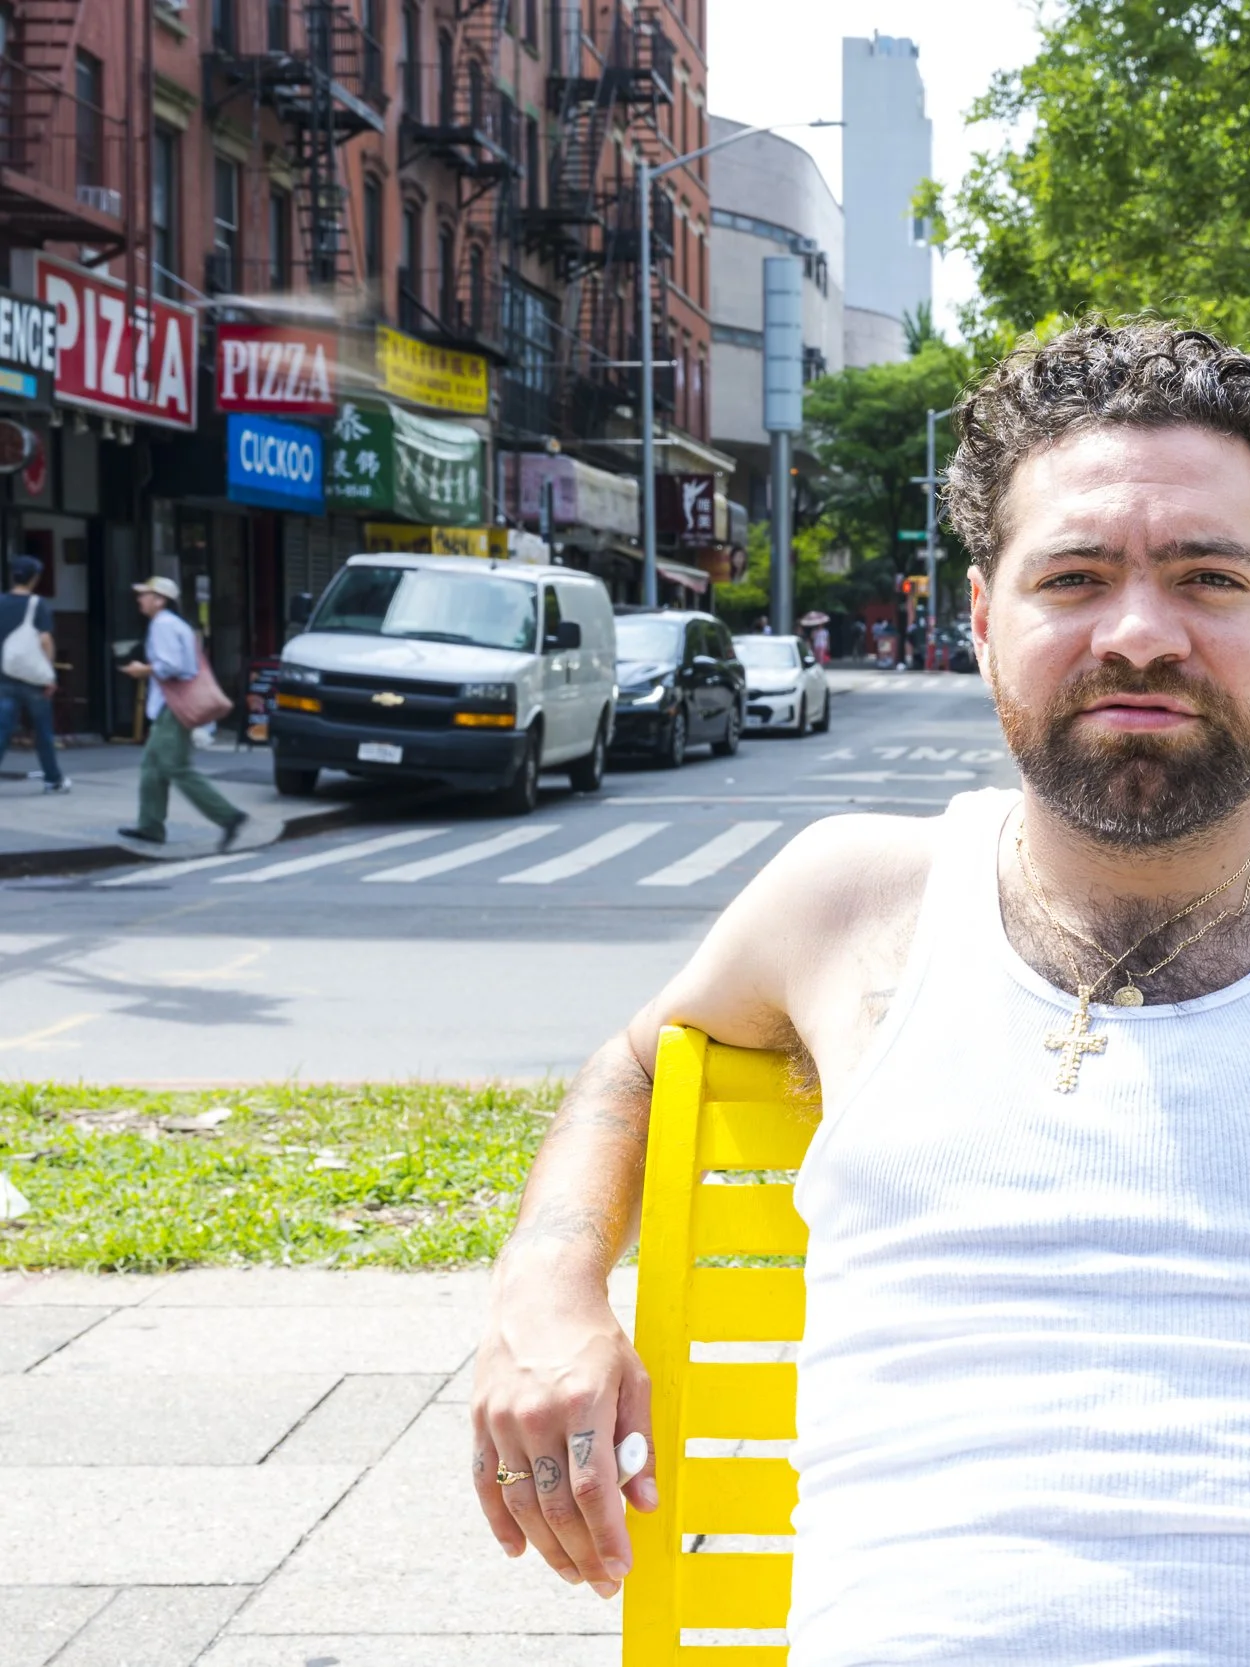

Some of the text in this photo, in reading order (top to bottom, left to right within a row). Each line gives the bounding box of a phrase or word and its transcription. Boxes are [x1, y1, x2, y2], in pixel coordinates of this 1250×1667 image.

[0, 297, 55, 372] ENCE
[45, 273, 188, 413] PIZZA
[220, 339, 333, 404] PIZZA
[239, 430, 314, 483] CUCKOO
[818, 747, 1005, 763] ONLY
